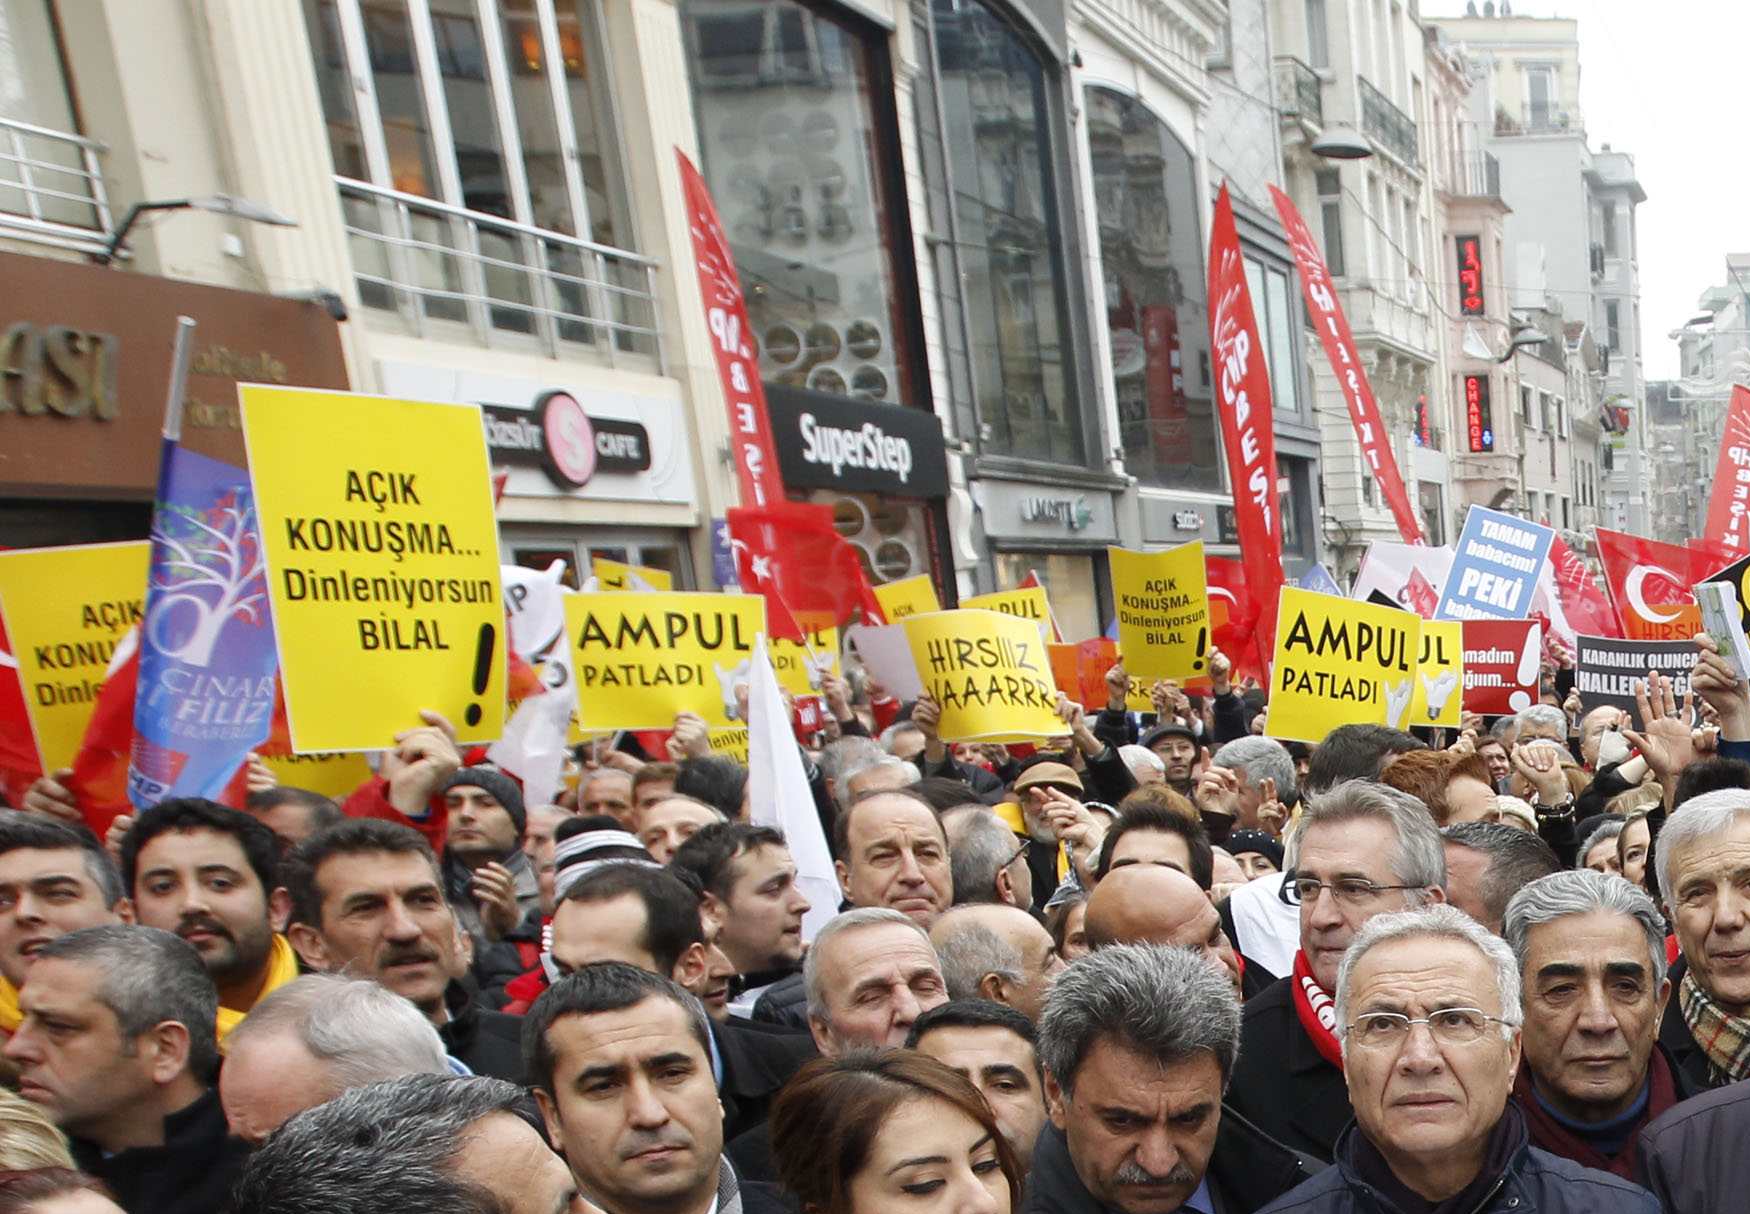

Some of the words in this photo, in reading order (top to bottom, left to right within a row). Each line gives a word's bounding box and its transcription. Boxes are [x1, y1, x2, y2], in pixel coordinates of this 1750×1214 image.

[1466, 377, 1484, 451] CHANGE
[596, 430, 641, 459] CAFE
[799, 412, 914, 484] SuperStep
[345, 470, 421, 513] AÇIK
[285, 516, 482, 564] KONUŞMA...
[1480, 519, 1538, 552] TAMAM
[282, 567, 494, 609] Dinleniyorsun
[1144, 577, 1177, 594] AÇIK
[1457, 566, 1523, 612] PEKİ
[82, 600, 144, 633] AÇIK
[357, 611, 451, 652] BİLAL
[579, 610, 750, 651] AMPUL
[1120, 609, 1206, 629] Dinleniyorsun
[1146, 629, 1186, 645] BİLAL
[1283, 608, 1409, 672] AMPUL
[1463, 645, 1515, 665] madım
[584, 662, 704, 688] PATLADI
[1581, 648, 1646, 670] KARANLIK
[1282, 667, 1378, 705] PATLADI
